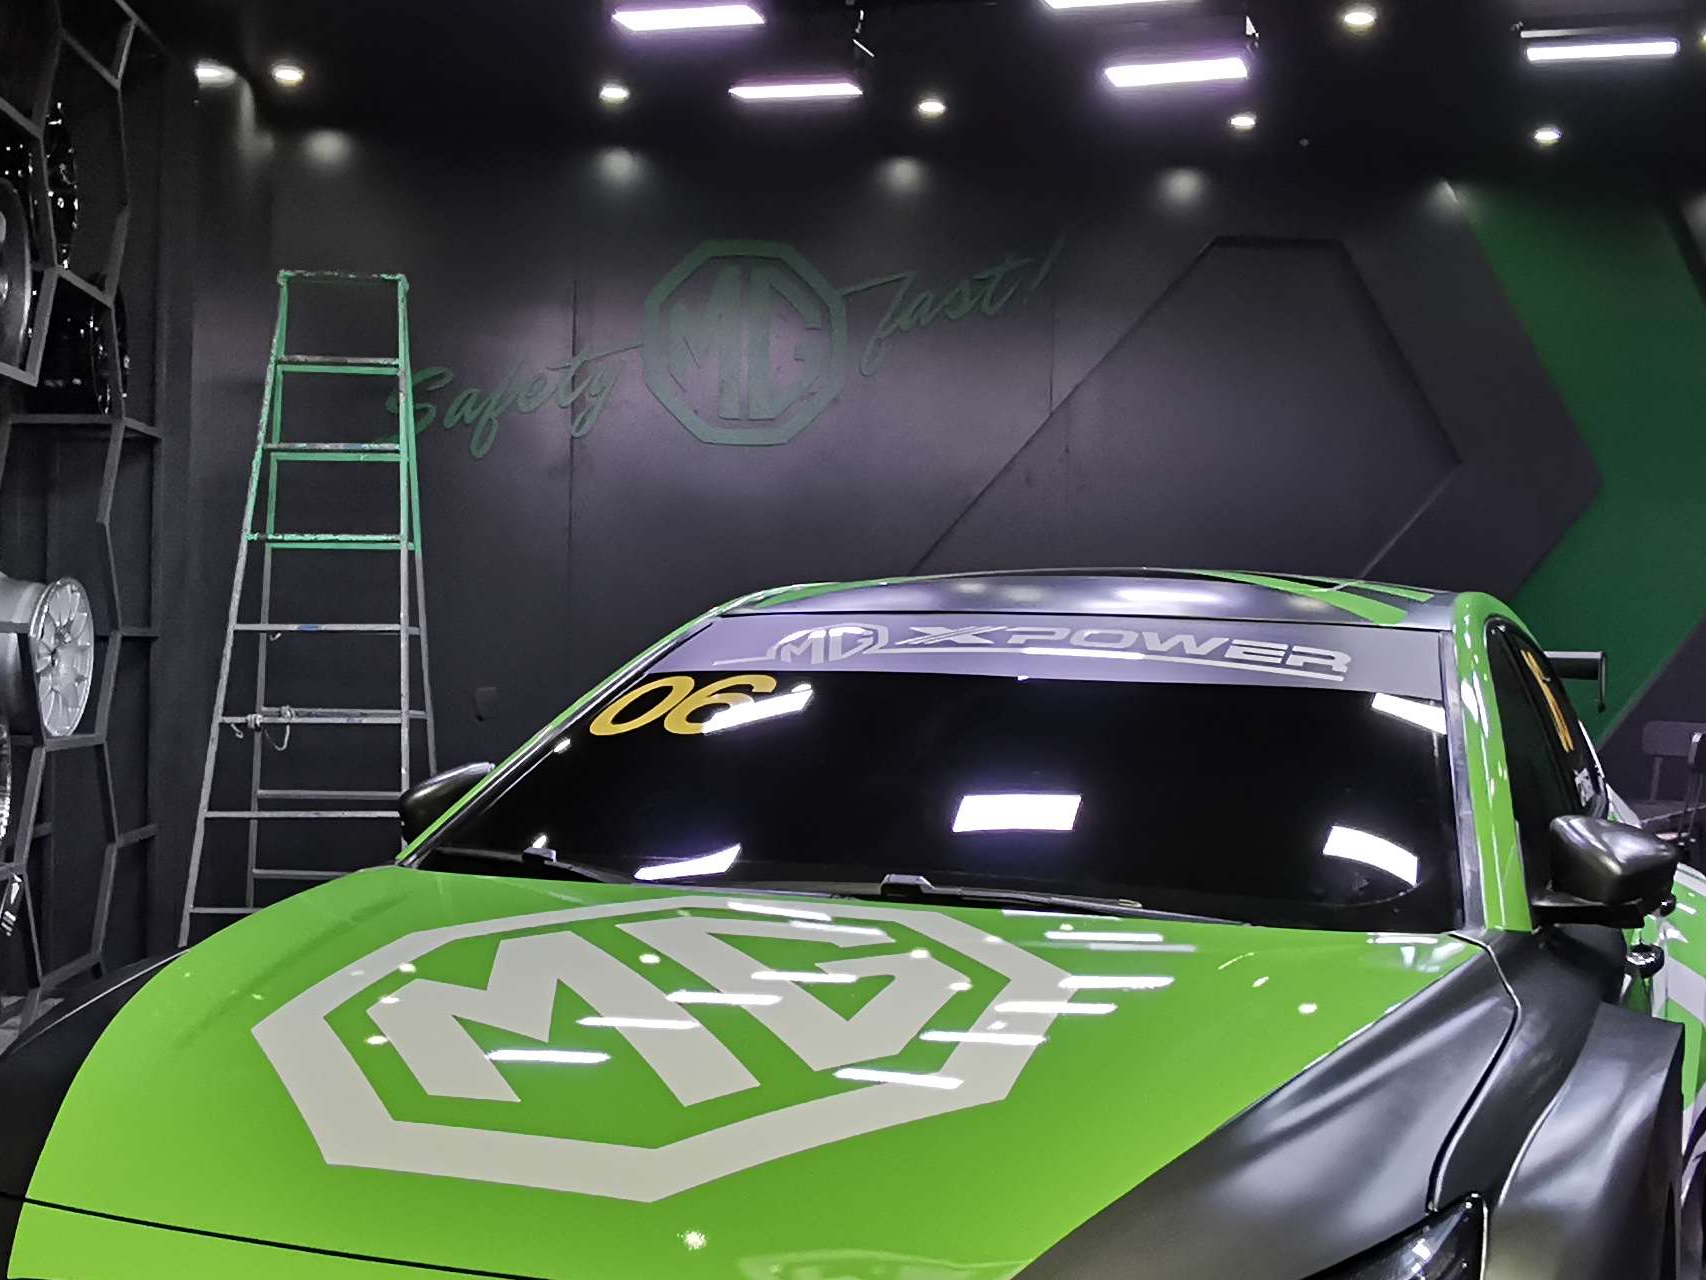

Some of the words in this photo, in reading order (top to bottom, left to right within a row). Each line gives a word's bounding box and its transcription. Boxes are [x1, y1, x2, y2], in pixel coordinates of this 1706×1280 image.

[779, 629, 877, 664] MG
[896, 625, 1353, 674] XPOWER
[589, 674, 777, 736] 06
[365, 917, 953, 1108] MG
